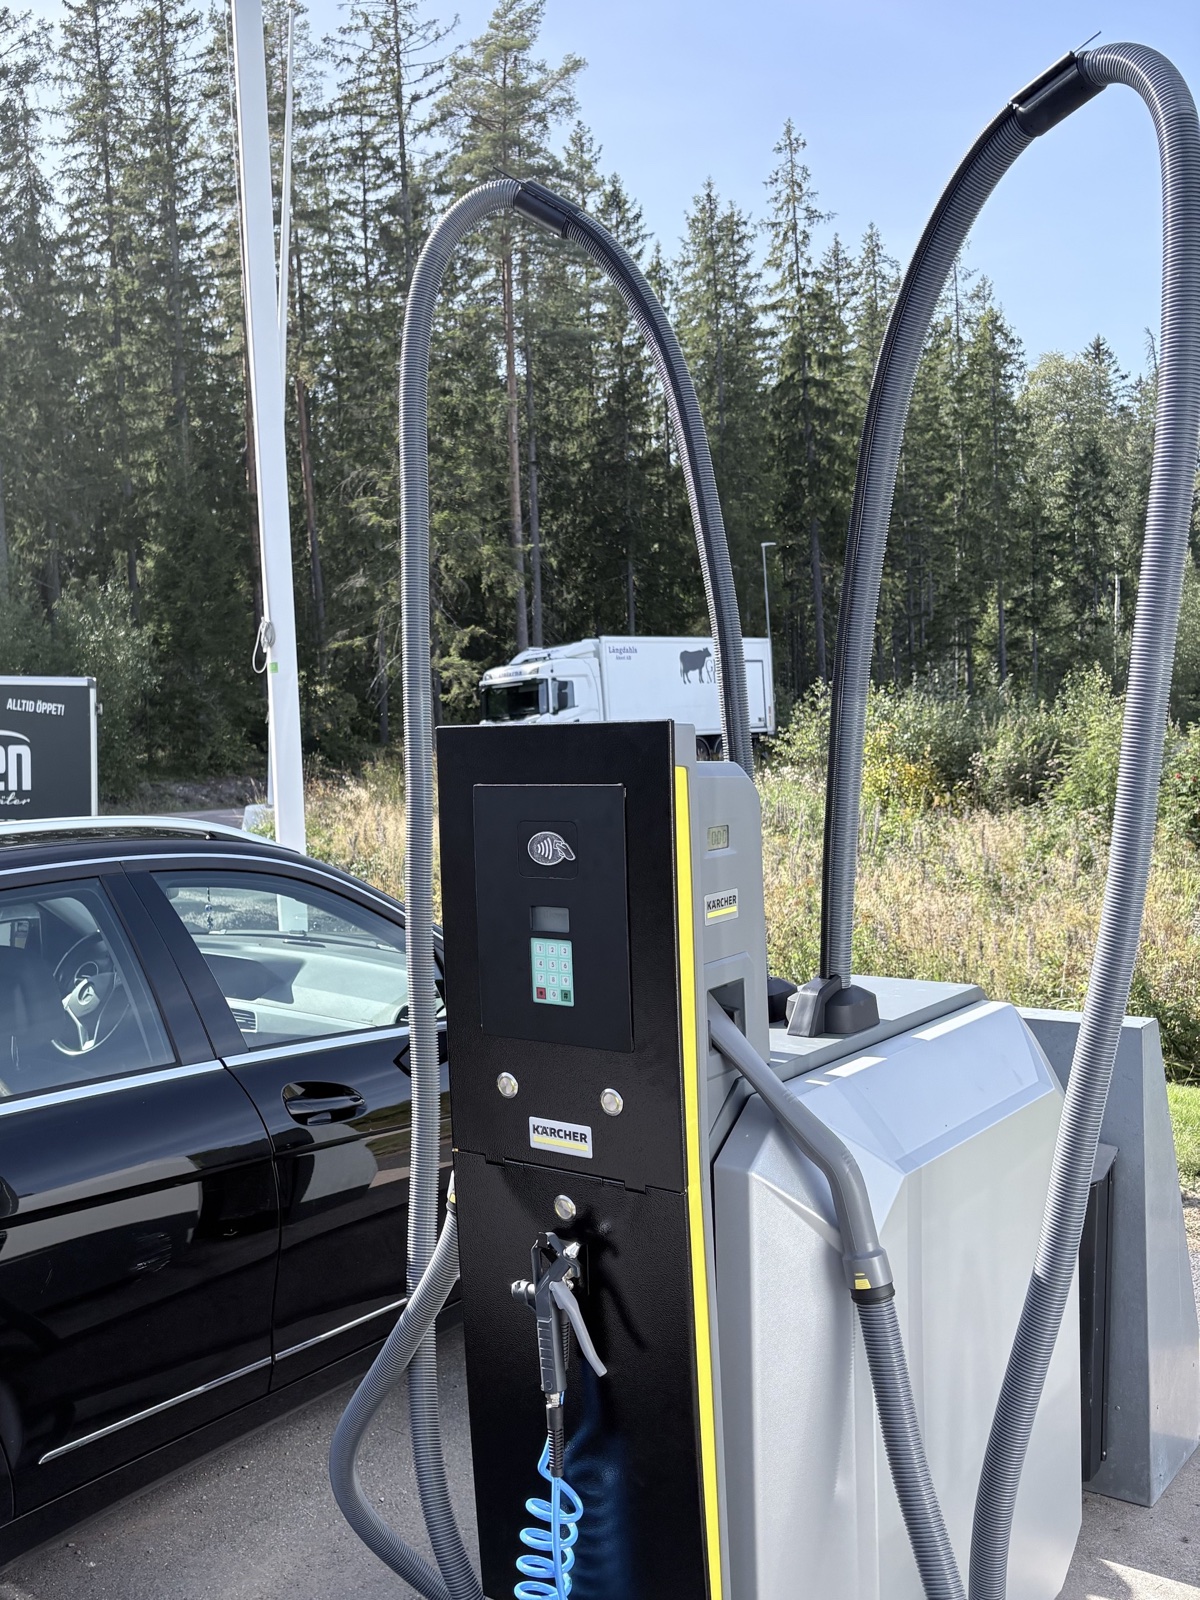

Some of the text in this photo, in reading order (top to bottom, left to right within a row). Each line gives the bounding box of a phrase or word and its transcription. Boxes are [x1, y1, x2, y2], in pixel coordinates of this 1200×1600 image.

[6, 698, 35, 713] ALLTID
[706, 895, 737, 911] KÄRCHER
[532, 1124, 588, 1143] KÄRCHER
